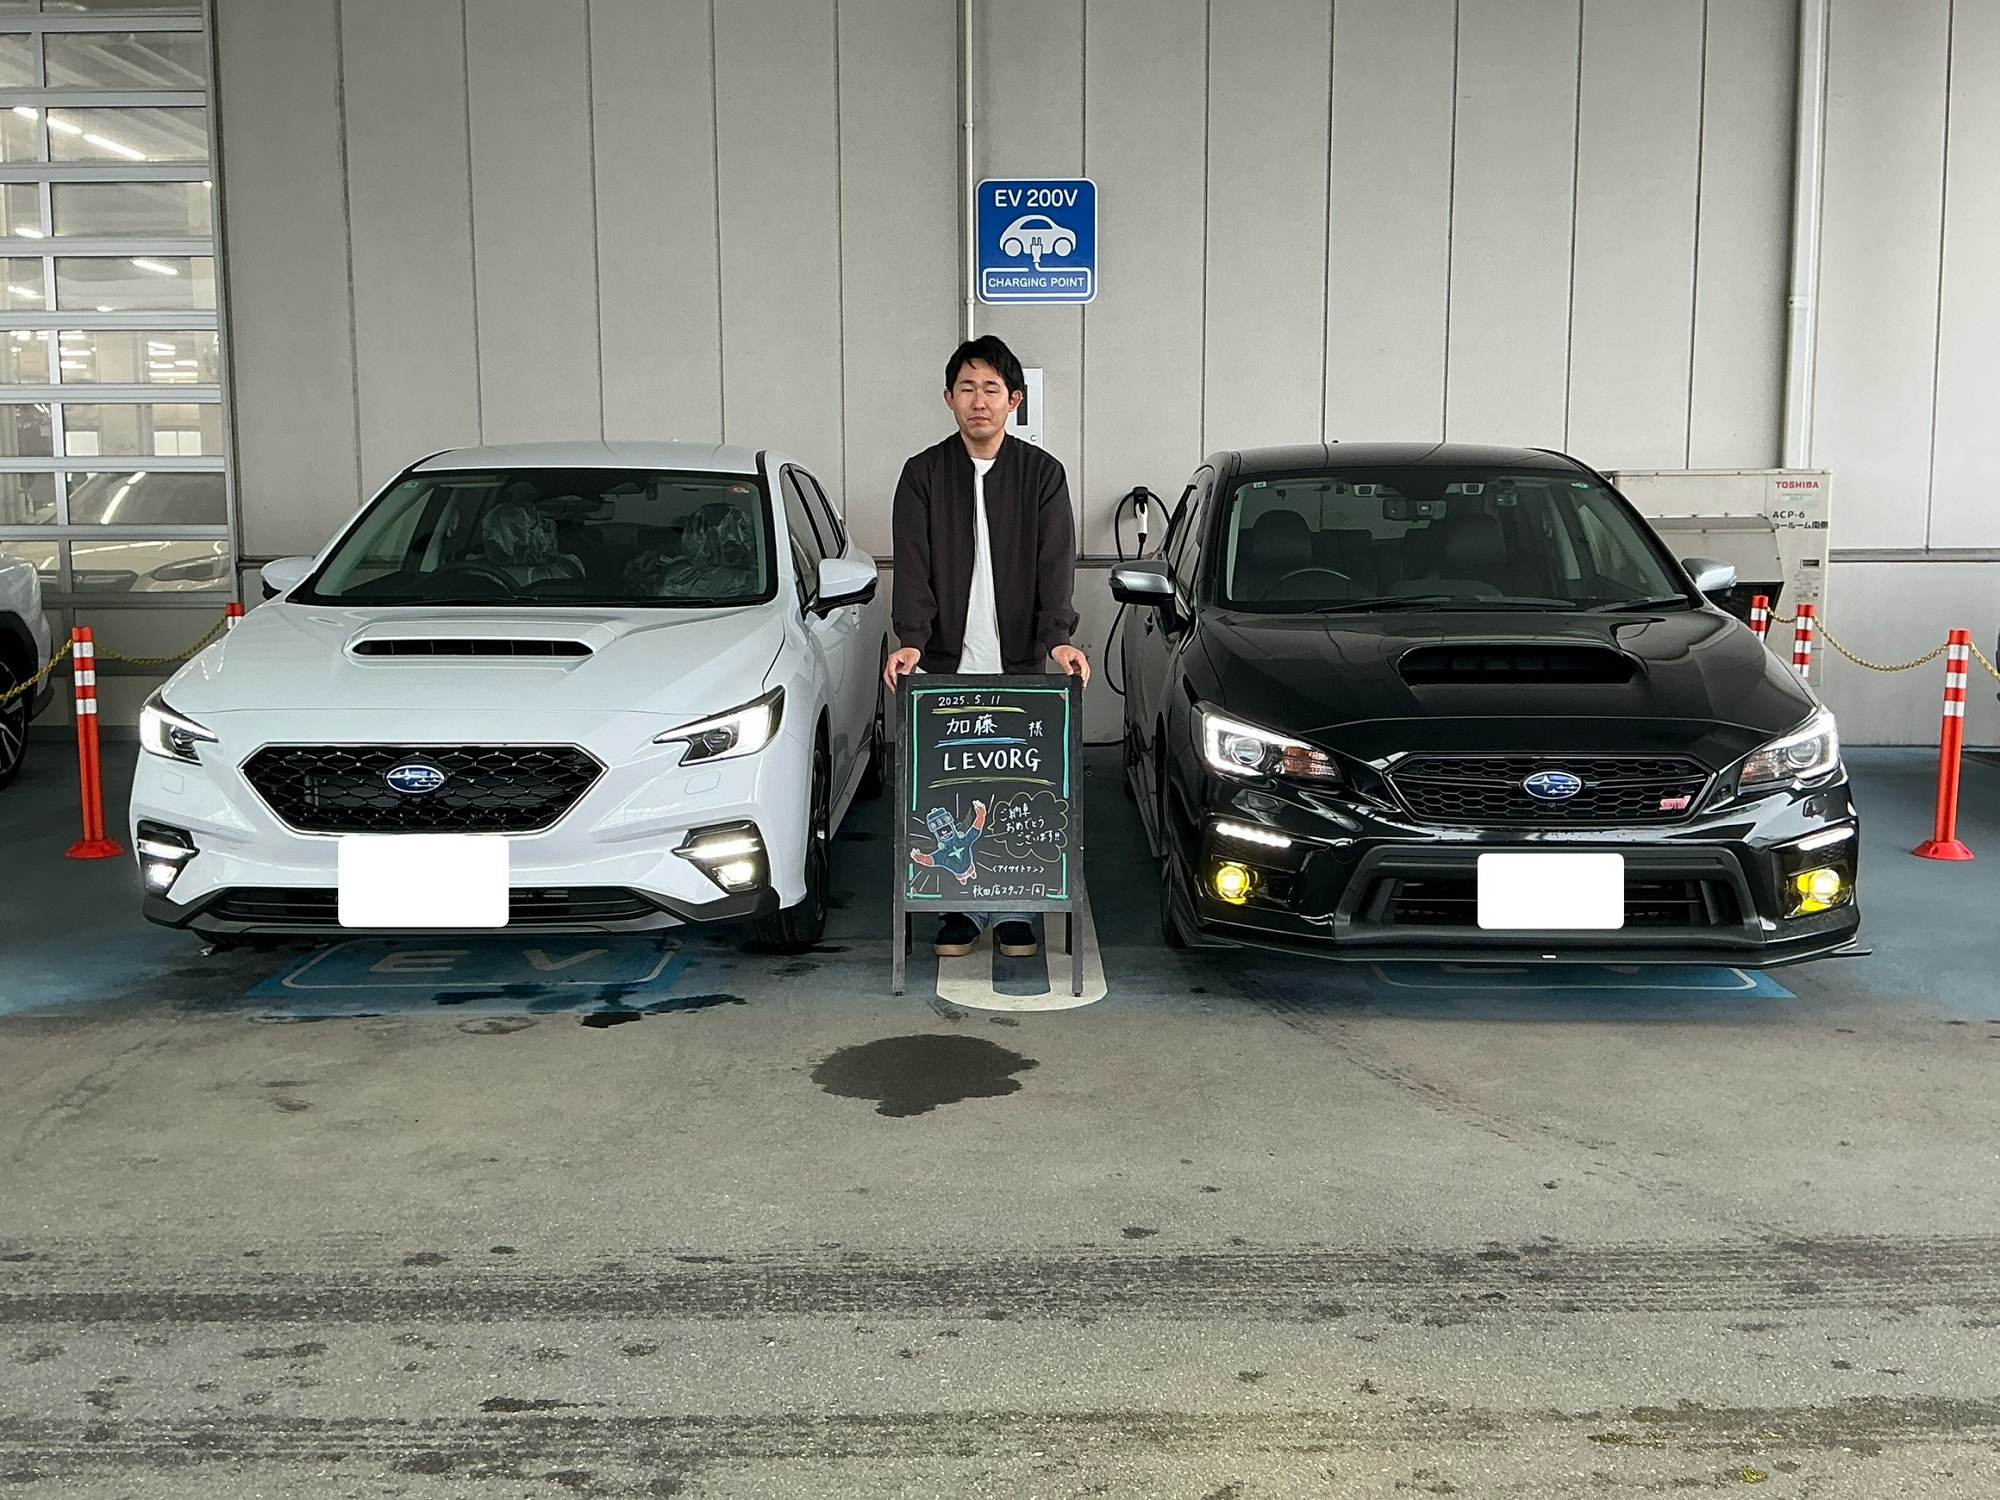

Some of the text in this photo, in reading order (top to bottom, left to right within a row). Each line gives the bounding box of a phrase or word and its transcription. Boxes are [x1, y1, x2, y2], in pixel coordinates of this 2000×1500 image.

[995, 189, 1078, 207] EV 200V
[988, 277, 1085, 288] CHARGING POINT
[1775, 481, 1819, 489] TOSHIBA
[1772, 510, 1805, 519] ACP-6
[946, 713, 1043, 738] 加藤 様
[943, 748, 1042, 772] LEVORG
[1000, 802, 1031, 821] ご納車
[1006, 815, 1045, 833] おめでとう
